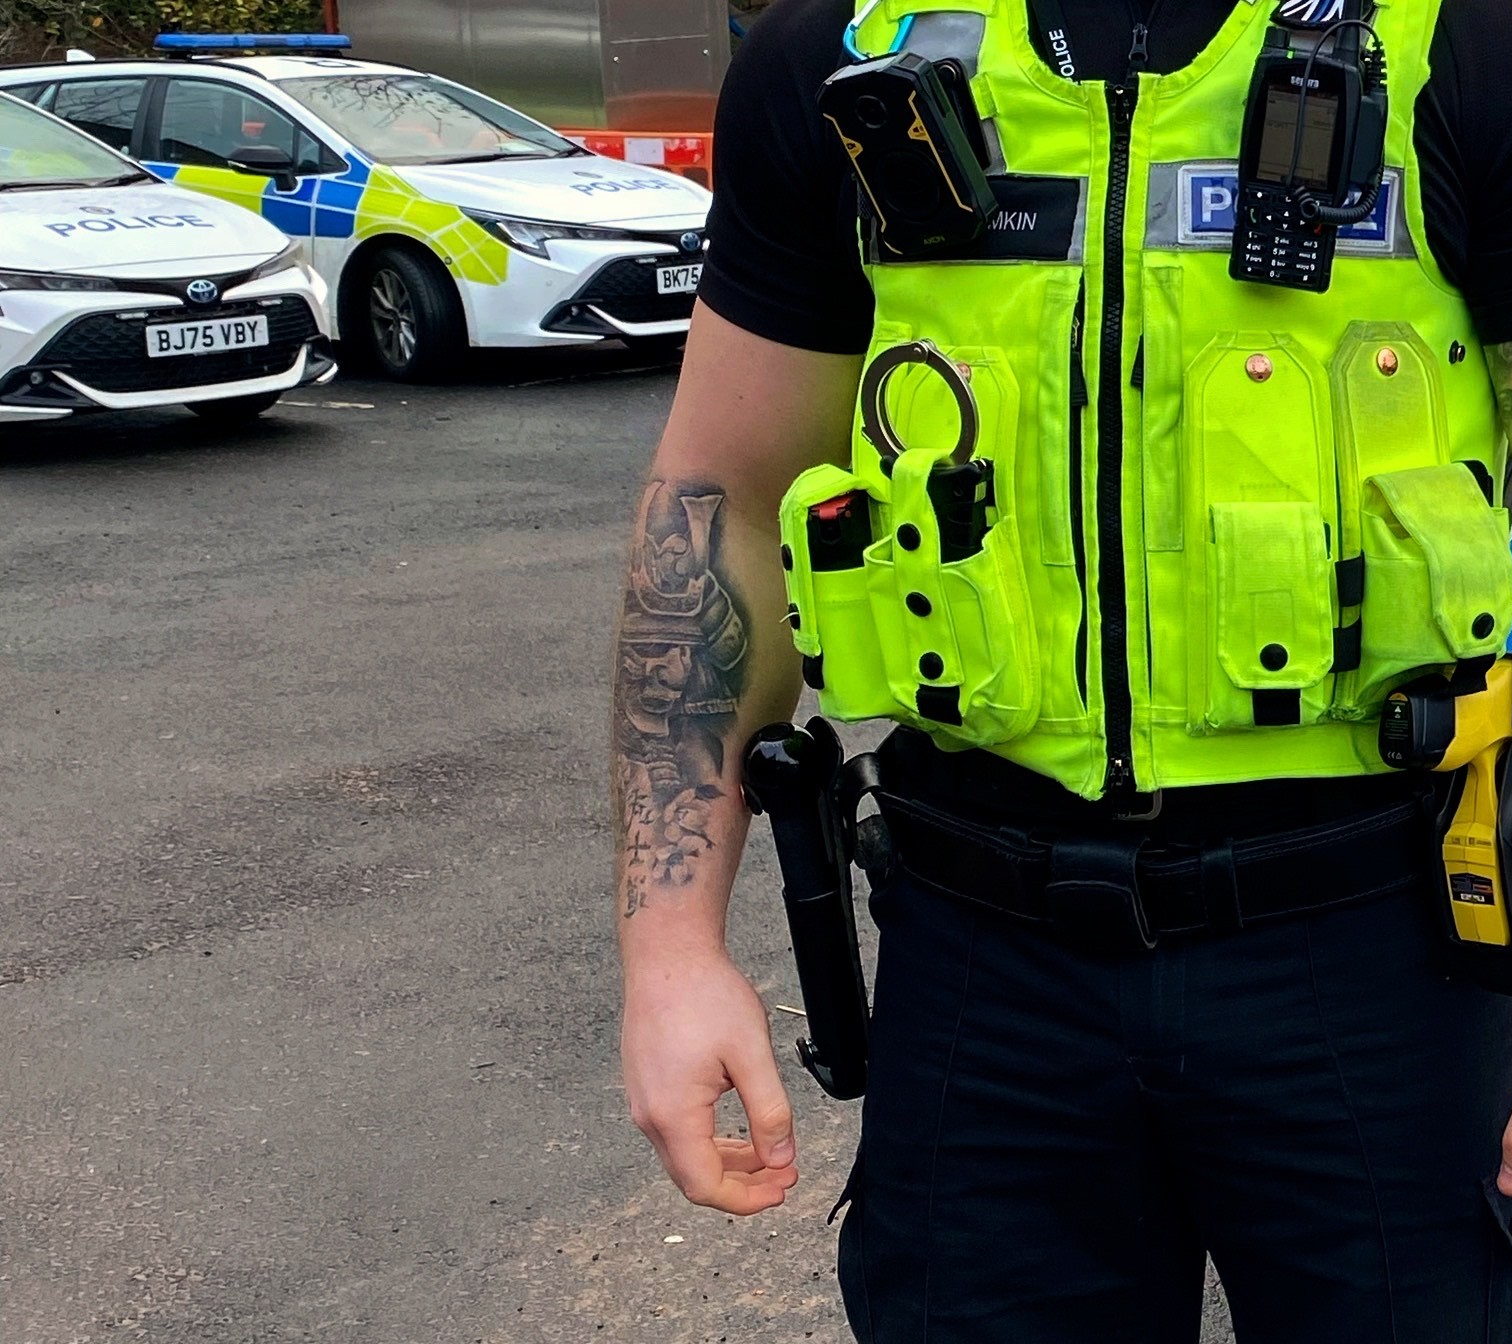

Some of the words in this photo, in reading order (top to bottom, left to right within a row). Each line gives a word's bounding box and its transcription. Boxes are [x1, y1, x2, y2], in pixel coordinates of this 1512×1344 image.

[1049, 29, 1076, 80] OLICE
[569, 179, 681, 197] POLICE
[45, 214, 215, 237] POLICE
[987, 210, 1037, 231] MKIN
[662, 267, 699, 289] BK75
[156, 325, 214, 352] BJ75
[220, 320, 258, 346] VBY
